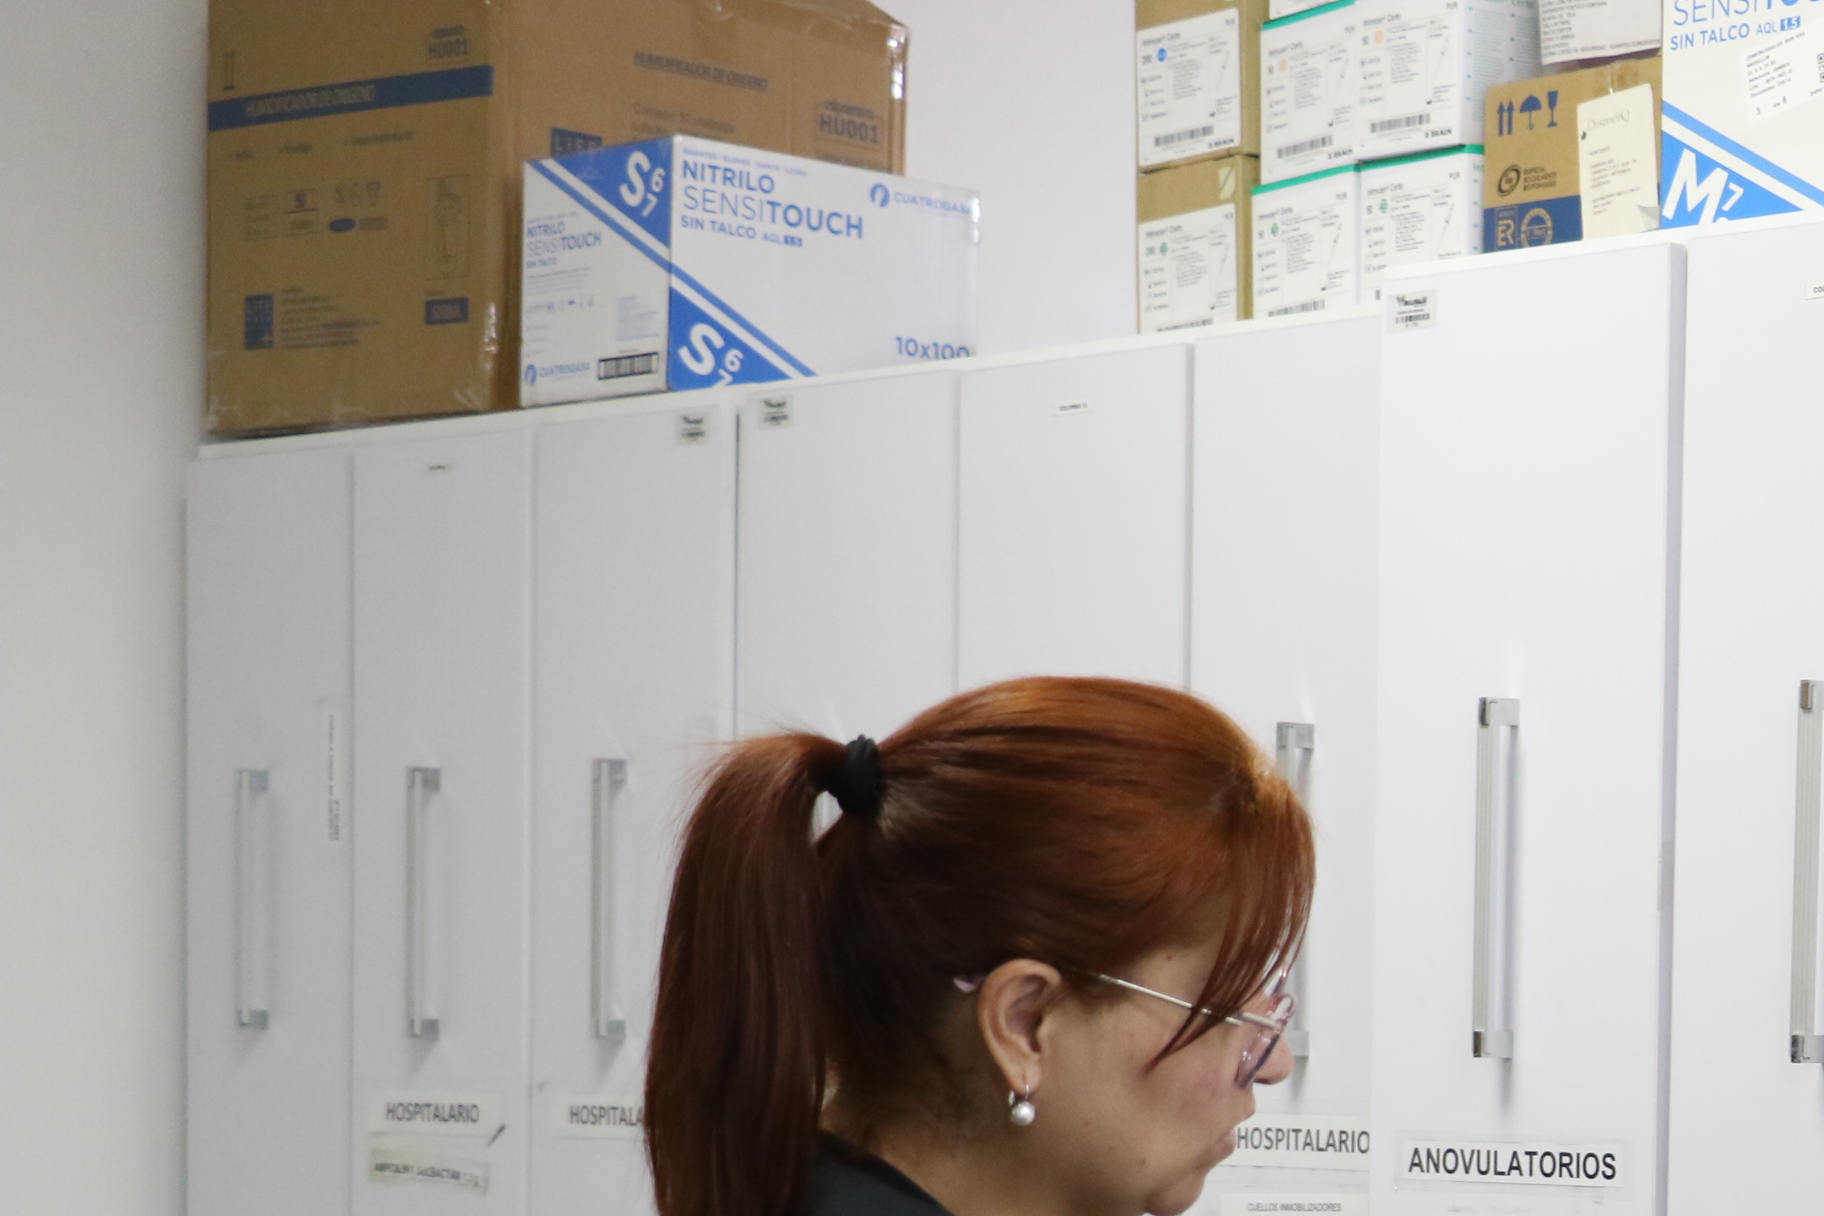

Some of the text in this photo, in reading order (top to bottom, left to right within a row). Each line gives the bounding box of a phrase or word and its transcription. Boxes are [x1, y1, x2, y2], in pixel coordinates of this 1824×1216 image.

[1670, 33, 1694, 51] SIN
[1700, 23, 1750, 46] TALCO
[1756, 22, 1778, 36] AQL
[819, 113, 879, 144] HU001
[620, 151, 667, 208] S 6
[683, 160, 775, 195] NITRILO
[1661, 147, 1730, 225] M
[681, 216, 704, 231] SIN
[711, 221, 757, 240] TALCO
[683, 185, 864, 240] SENSITOUCH
[527, 221, 566, 239] NITRILO
[678, 322, 725, 376] S
[385, 1103, 480, 1123] HOSPITALARIO
[1236, 1127, 1370, 1154] HOSPITALARIO
[1408, 1147, 1617, 1180] ANOVULATORIOS
